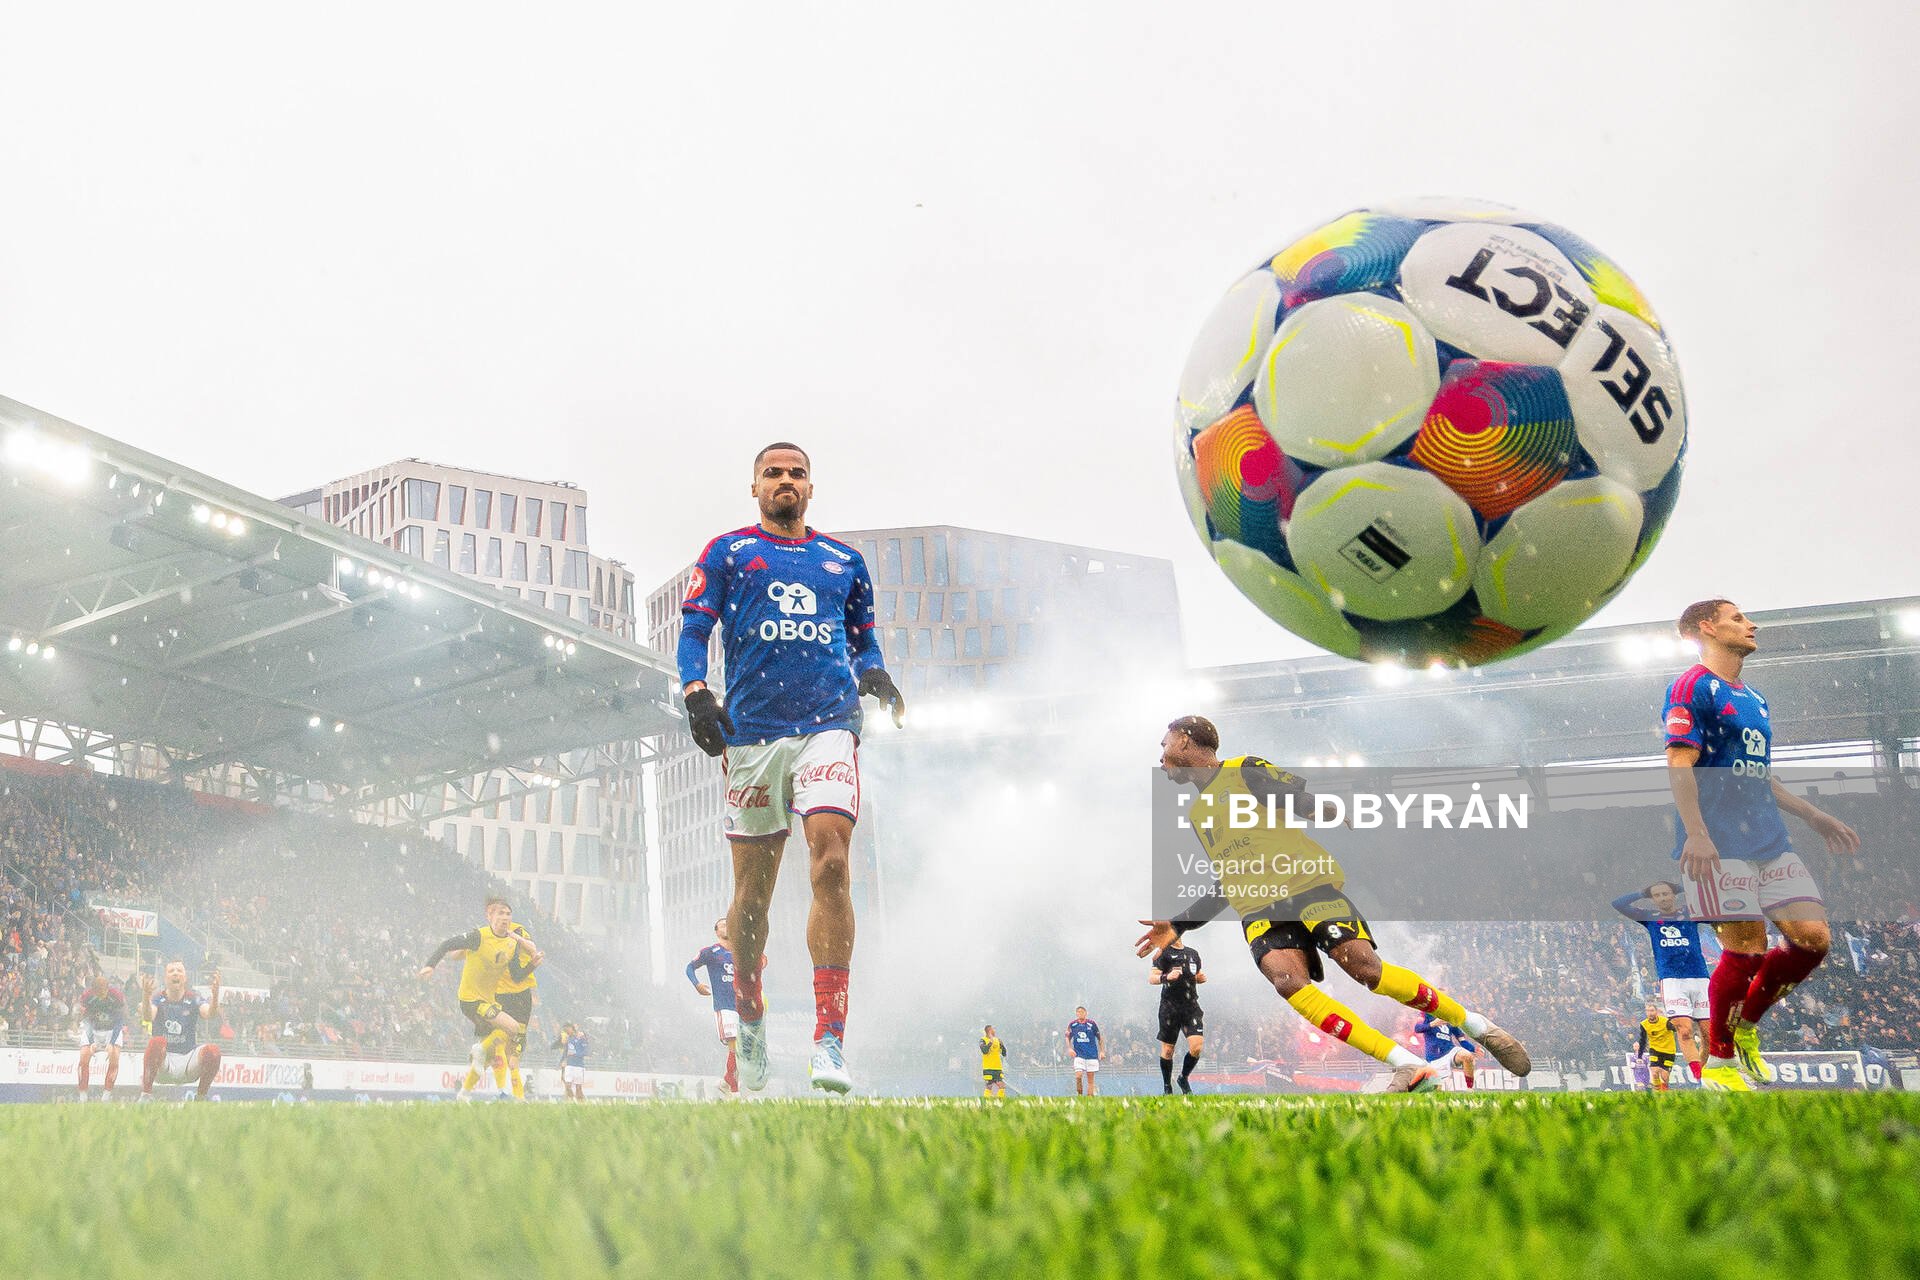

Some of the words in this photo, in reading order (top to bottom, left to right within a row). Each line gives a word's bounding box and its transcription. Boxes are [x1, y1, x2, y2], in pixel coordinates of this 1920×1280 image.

[1445, 248, 1673, 445] SELECT
[759, 619, 832, 645] OBOS
[1327, 924, 1342, 939] 9
[1659, 937, 1690, 947] OBOS
[213, 1063, 265, 1085] sloTaxi
